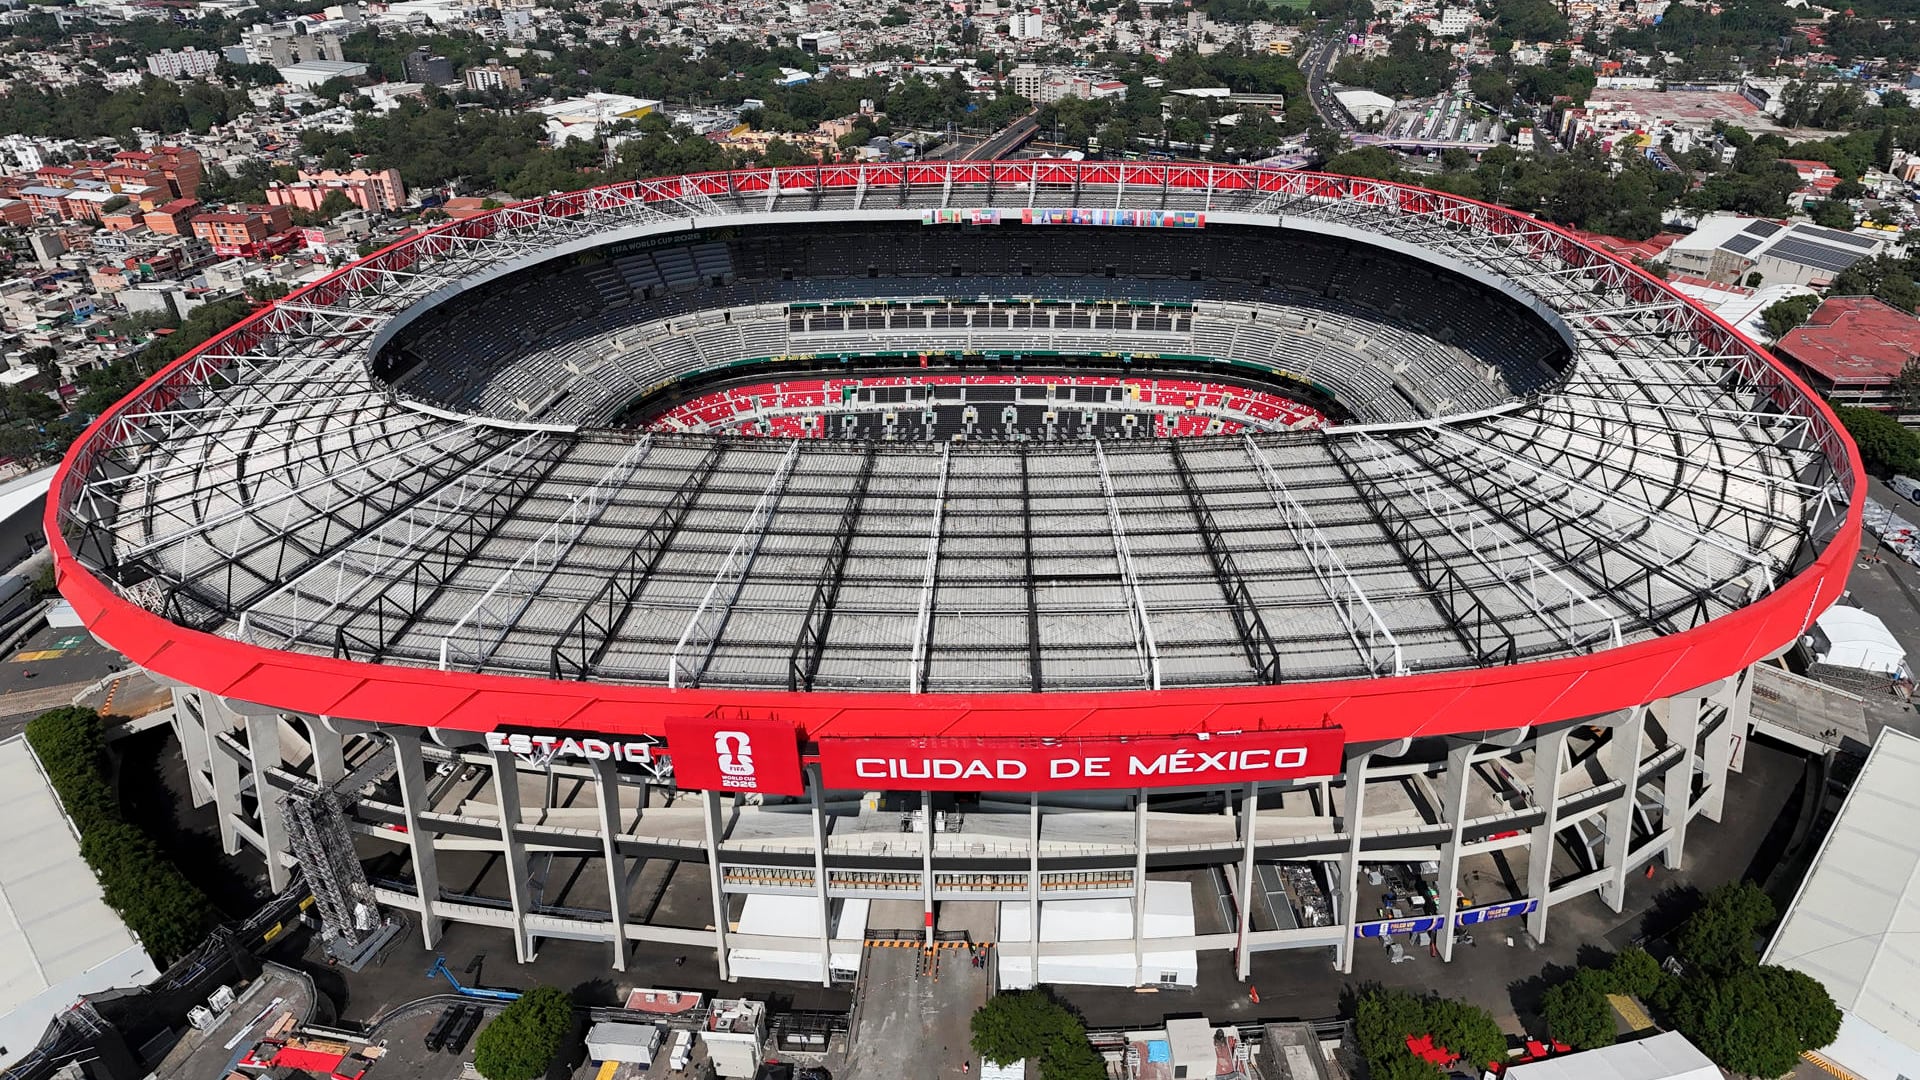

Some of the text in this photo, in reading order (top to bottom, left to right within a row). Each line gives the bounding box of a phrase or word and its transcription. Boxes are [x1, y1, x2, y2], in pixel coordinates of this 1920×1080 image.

[611, 233, 701, 255] FIFA WORLD CUP 2026
[485, 732, 650, 763] ESTADIO
[855, 748, 1308, 779] CIUDAD DE MÉXICO
[722, 780, 757, 788] 2026
